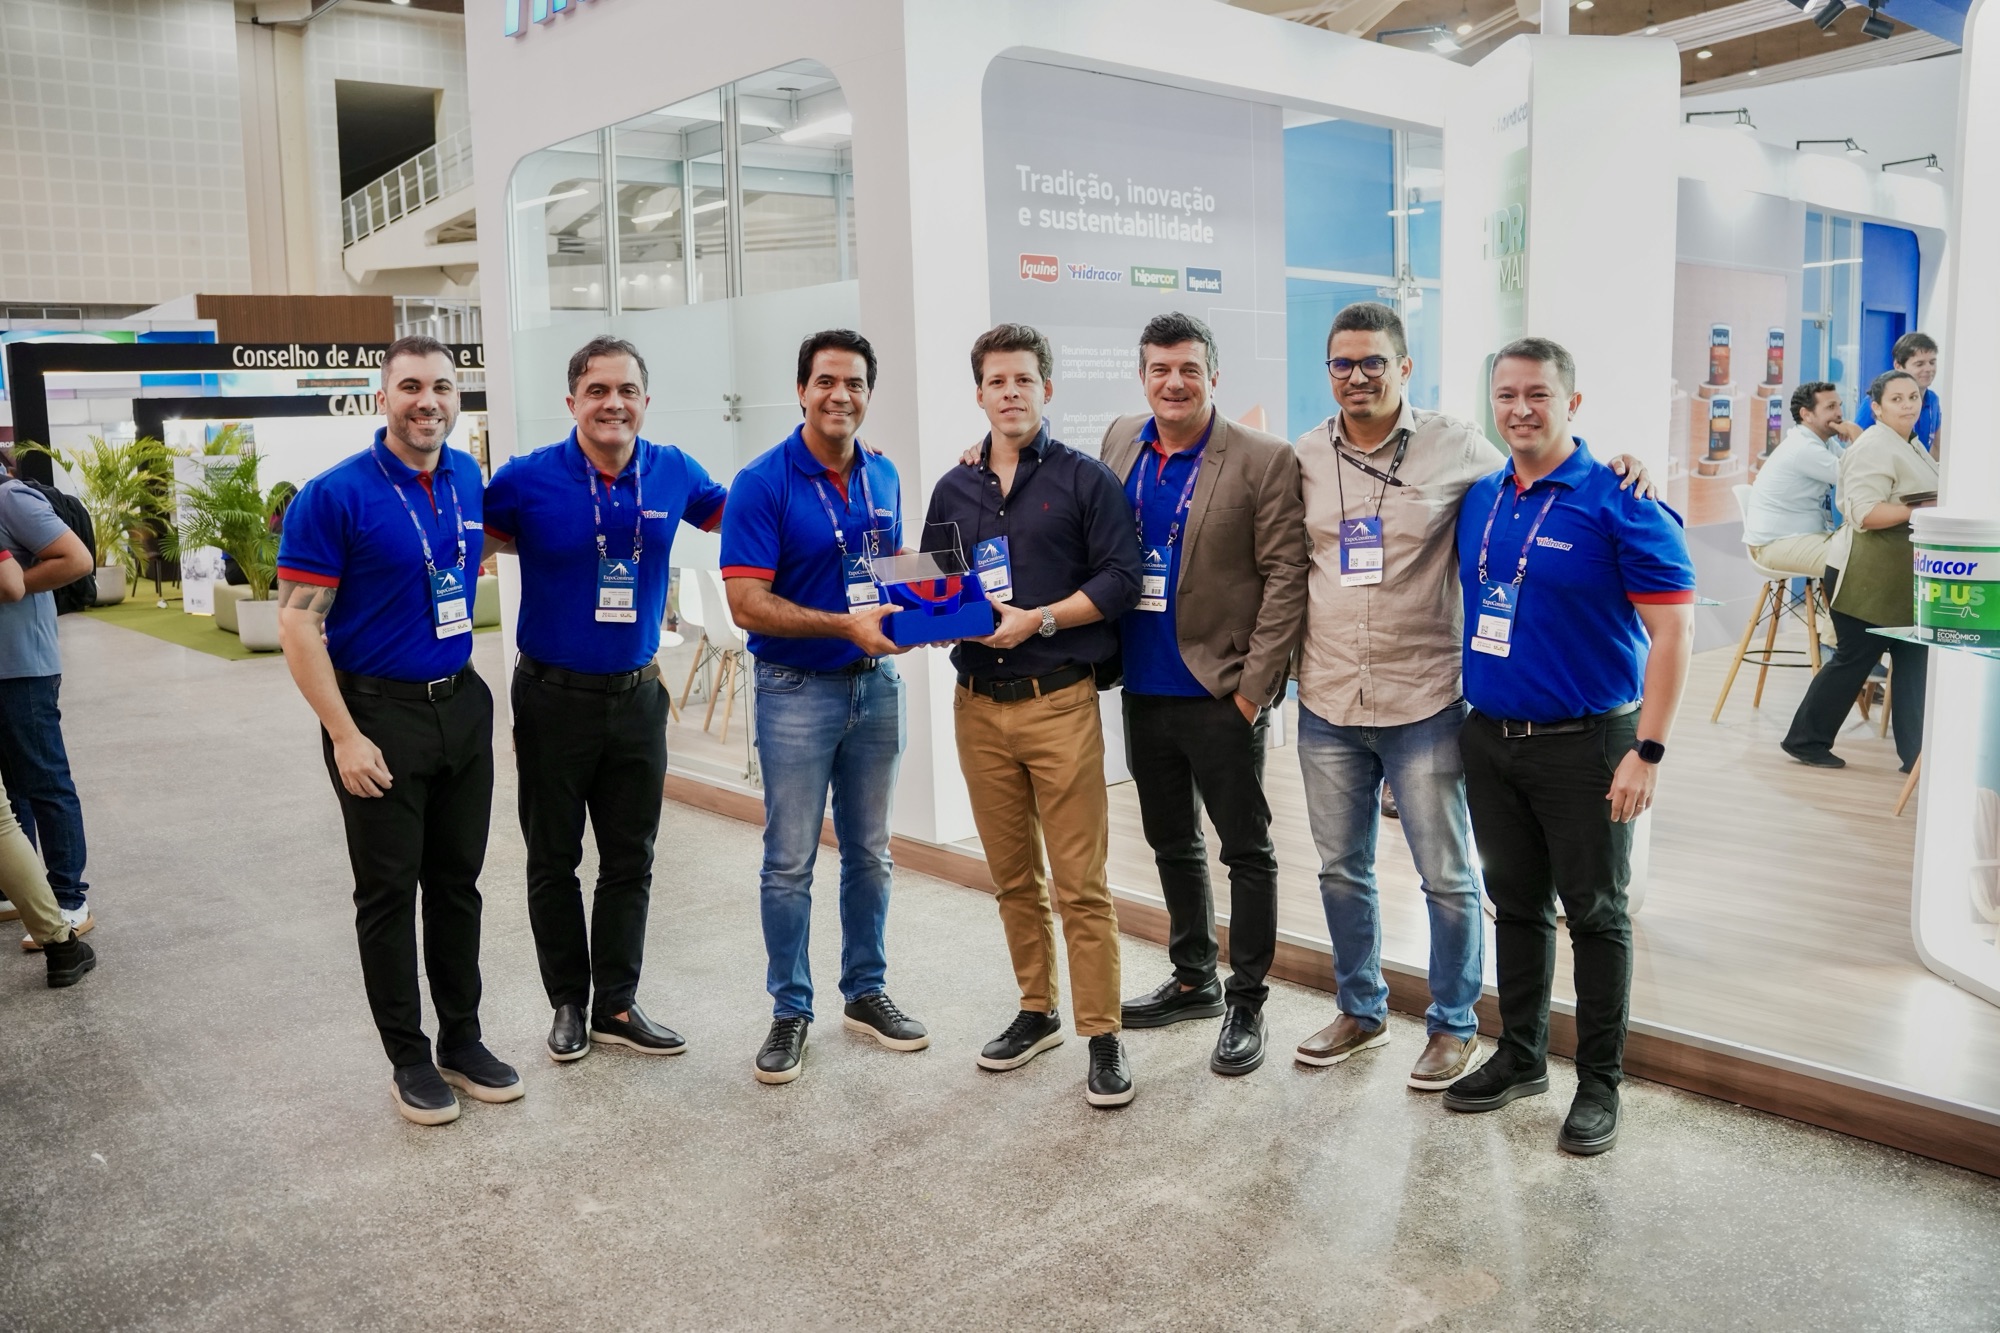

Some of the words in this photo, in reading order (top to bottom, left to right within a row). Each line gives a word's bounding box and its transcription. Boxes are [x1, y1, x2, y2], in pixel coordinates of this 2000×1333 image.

[1016, 164, 1120, 206] Tradição,
[1127, 178, 1216, 216] inovação
[1018, 206, 1032, 226] e
[1039, 208, 1214, 244] sustentabilidade
[1022, 260, 1057, 277] Iquine
[1067, 264, 1123, 282] Hidracor
[1134, 269, 1176, 285] hipercor
[232, 344, 319, 367] Conselho
[325, 345, 349, 367] de
[460, 349, 471, 366] e
[1061, 345, 1099, 356] Reunimos
[1100, 348, 1112, 356] um
[1113, 347, 1129, 357] time
[1061, 358, 1115, 371] comprometido
[1116, 361, 1122, 369] e
[1122, 361, 1135, 371] que
[1062, 369, 1087, 380] paixão
[1088, 369, 1105, 380] pelo
[1106, 372, 1120, 381] que
[328, 394, 377, 416] CAU
[1345, 533, 1378, 544] ExpoConstruir
[1536, 537, 1573, 551] Hidracor
[1937, 631, 1981, 642] ECONÔMICO
